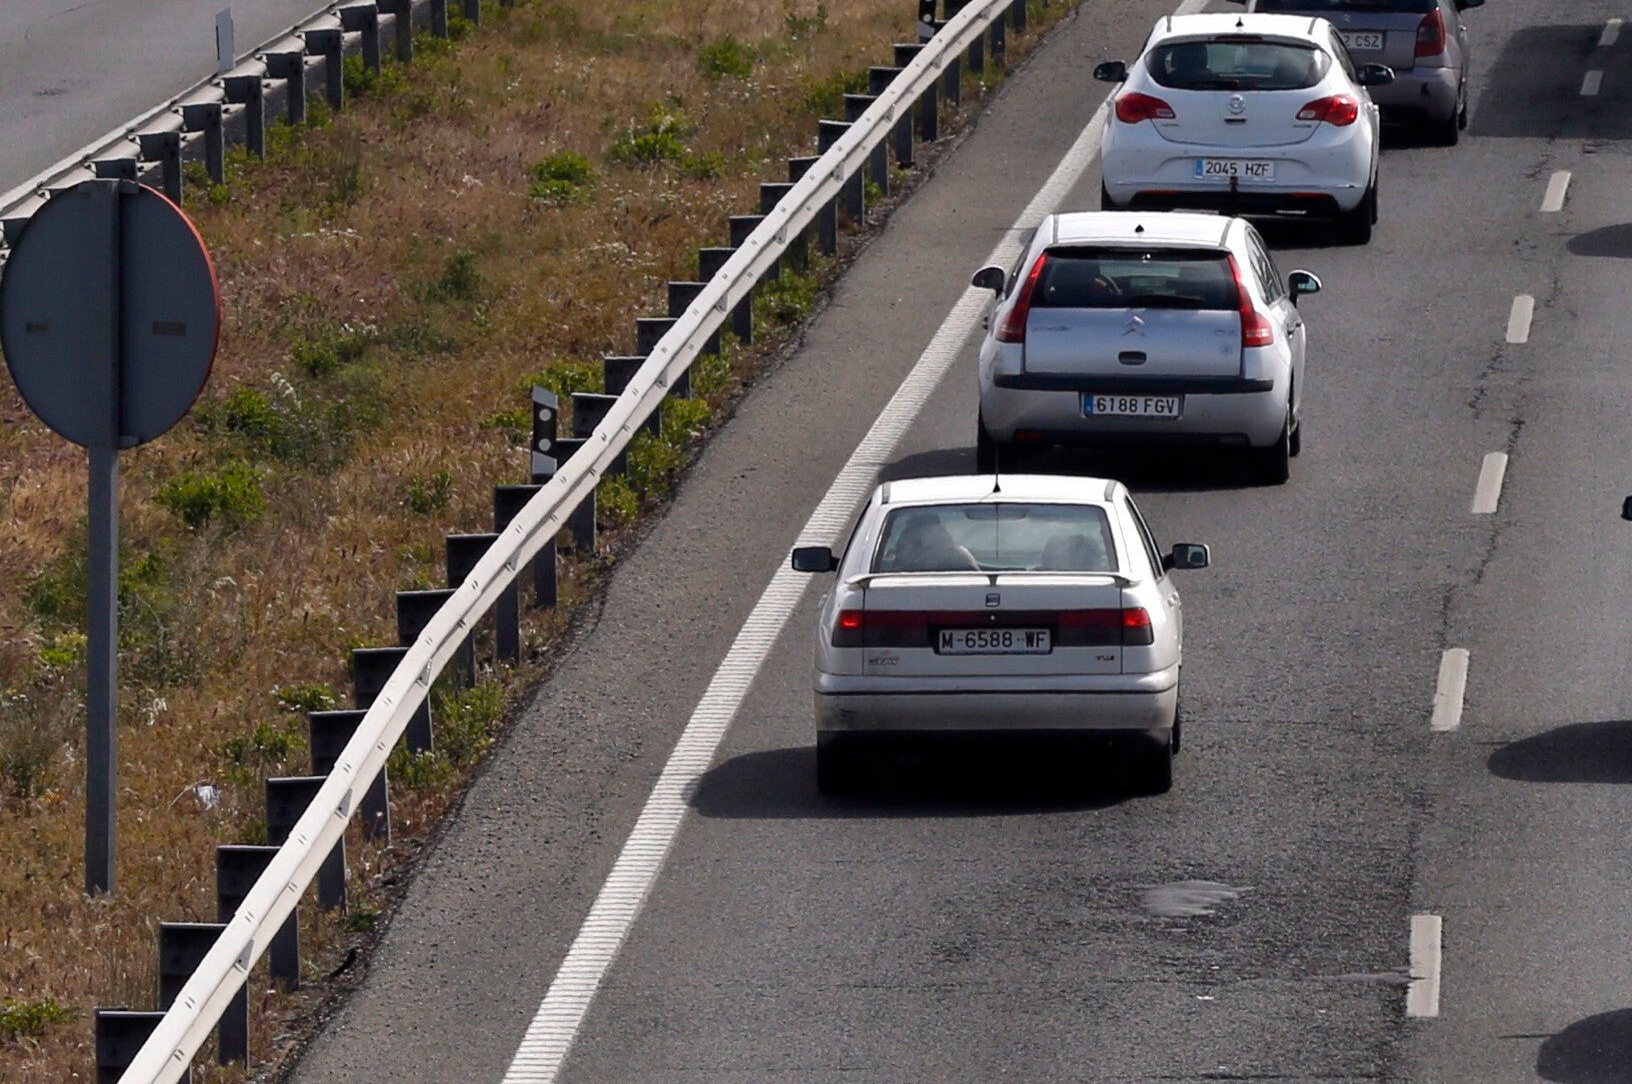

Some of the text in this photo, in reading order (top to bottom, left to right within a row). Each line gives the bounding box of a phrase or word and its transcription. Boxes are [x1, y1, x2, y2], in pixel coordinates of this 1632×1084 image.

[1355, 35, 1380, 47] CSZ
[1206, 161, 1270, 176] 2045 HZF
[1097, 397, 1175, 414] 6188 FGV
